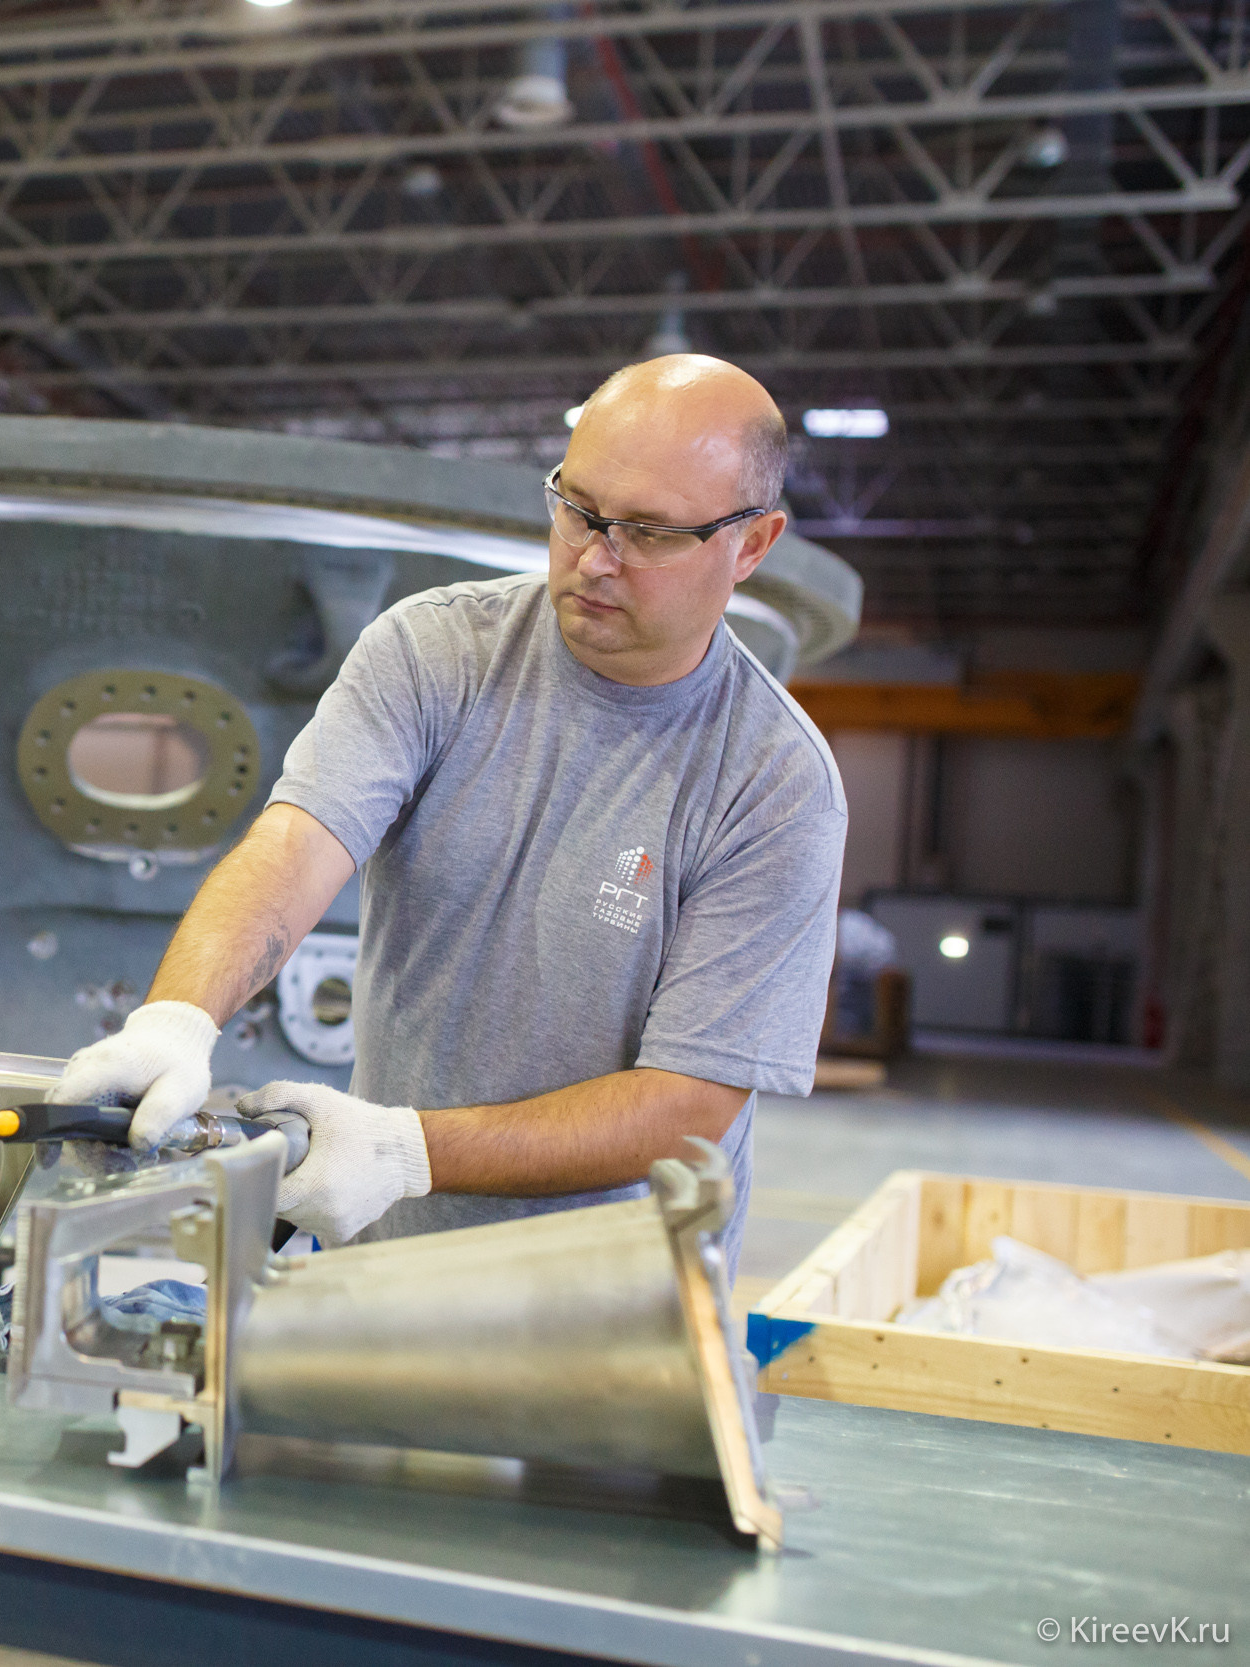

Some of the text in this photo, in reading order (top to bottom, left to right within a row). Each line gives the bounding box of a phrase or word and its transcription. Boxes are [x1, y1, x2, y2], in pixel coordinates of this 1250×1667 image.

[599, 881, 648, 908] РГТ
[593, 905, 641, 928] ГАЗОВЫЕ
[595, 898, 643, 921] РУССКИЕ
[592, 911, 638, 934] ТУРБИНЫ
